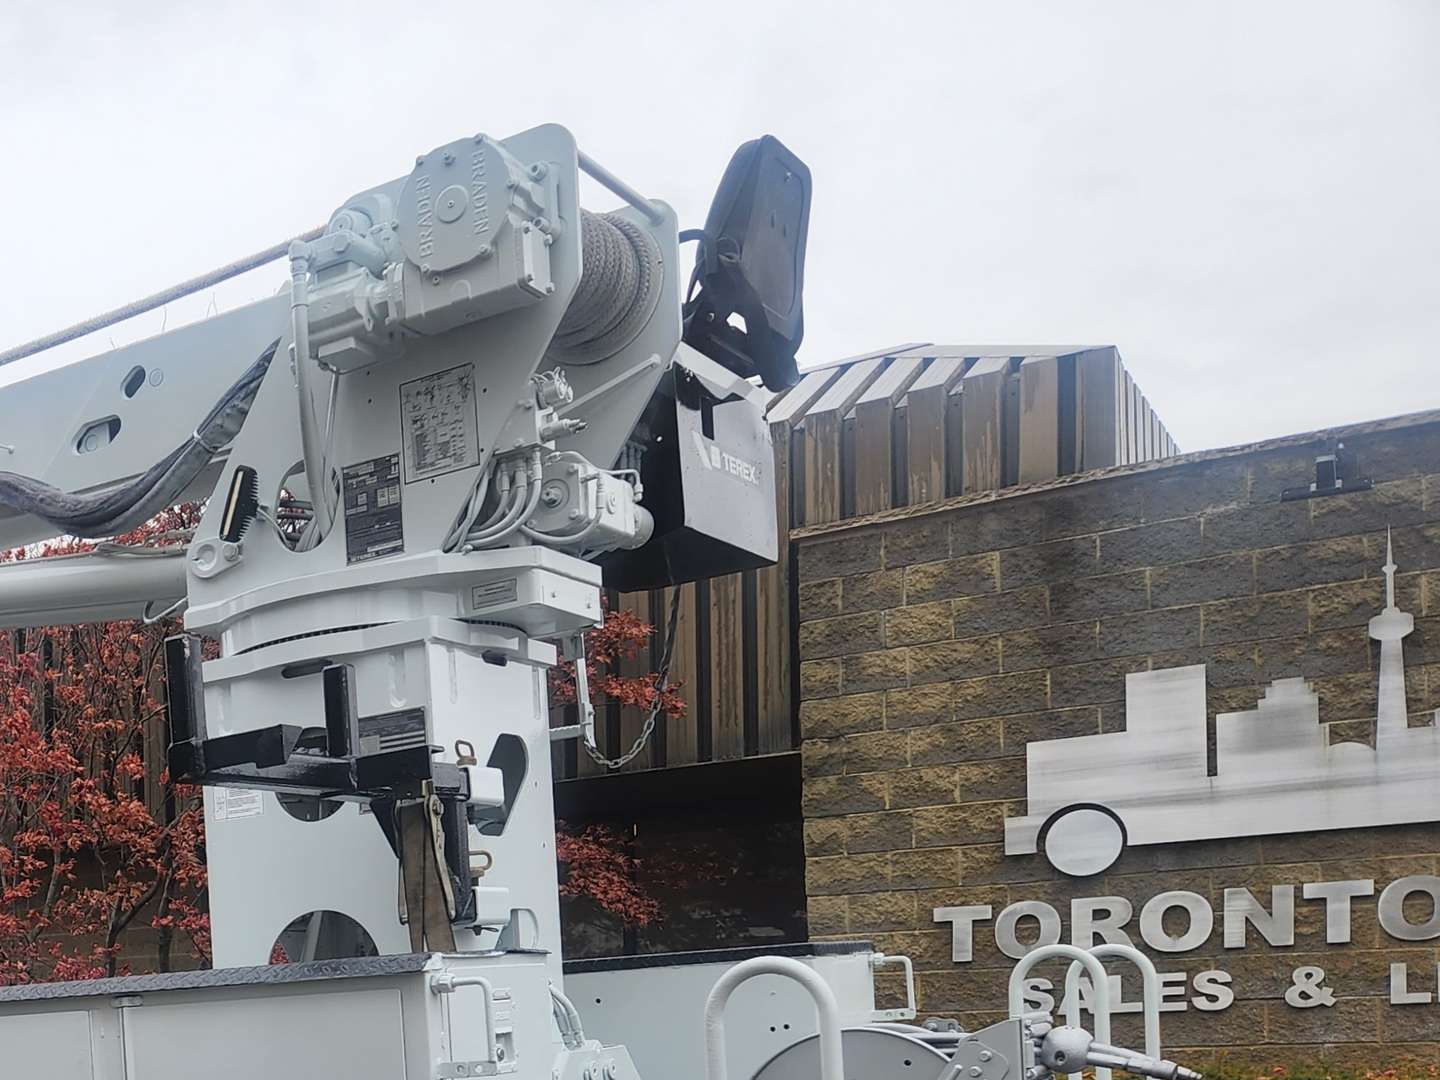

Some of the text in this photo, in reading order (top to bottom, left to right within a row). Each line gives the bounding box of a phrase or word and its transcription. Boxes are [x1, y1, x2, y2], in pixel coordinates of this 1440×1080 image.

[416, 174, 434, 259] BRADEN
[471, 149, 490, 236] BRADEN
[721, 451, 759, 486] TEREX
[933, 875, 1440, 963] TORONTO
[1284, 965, 1338, 1008] &
